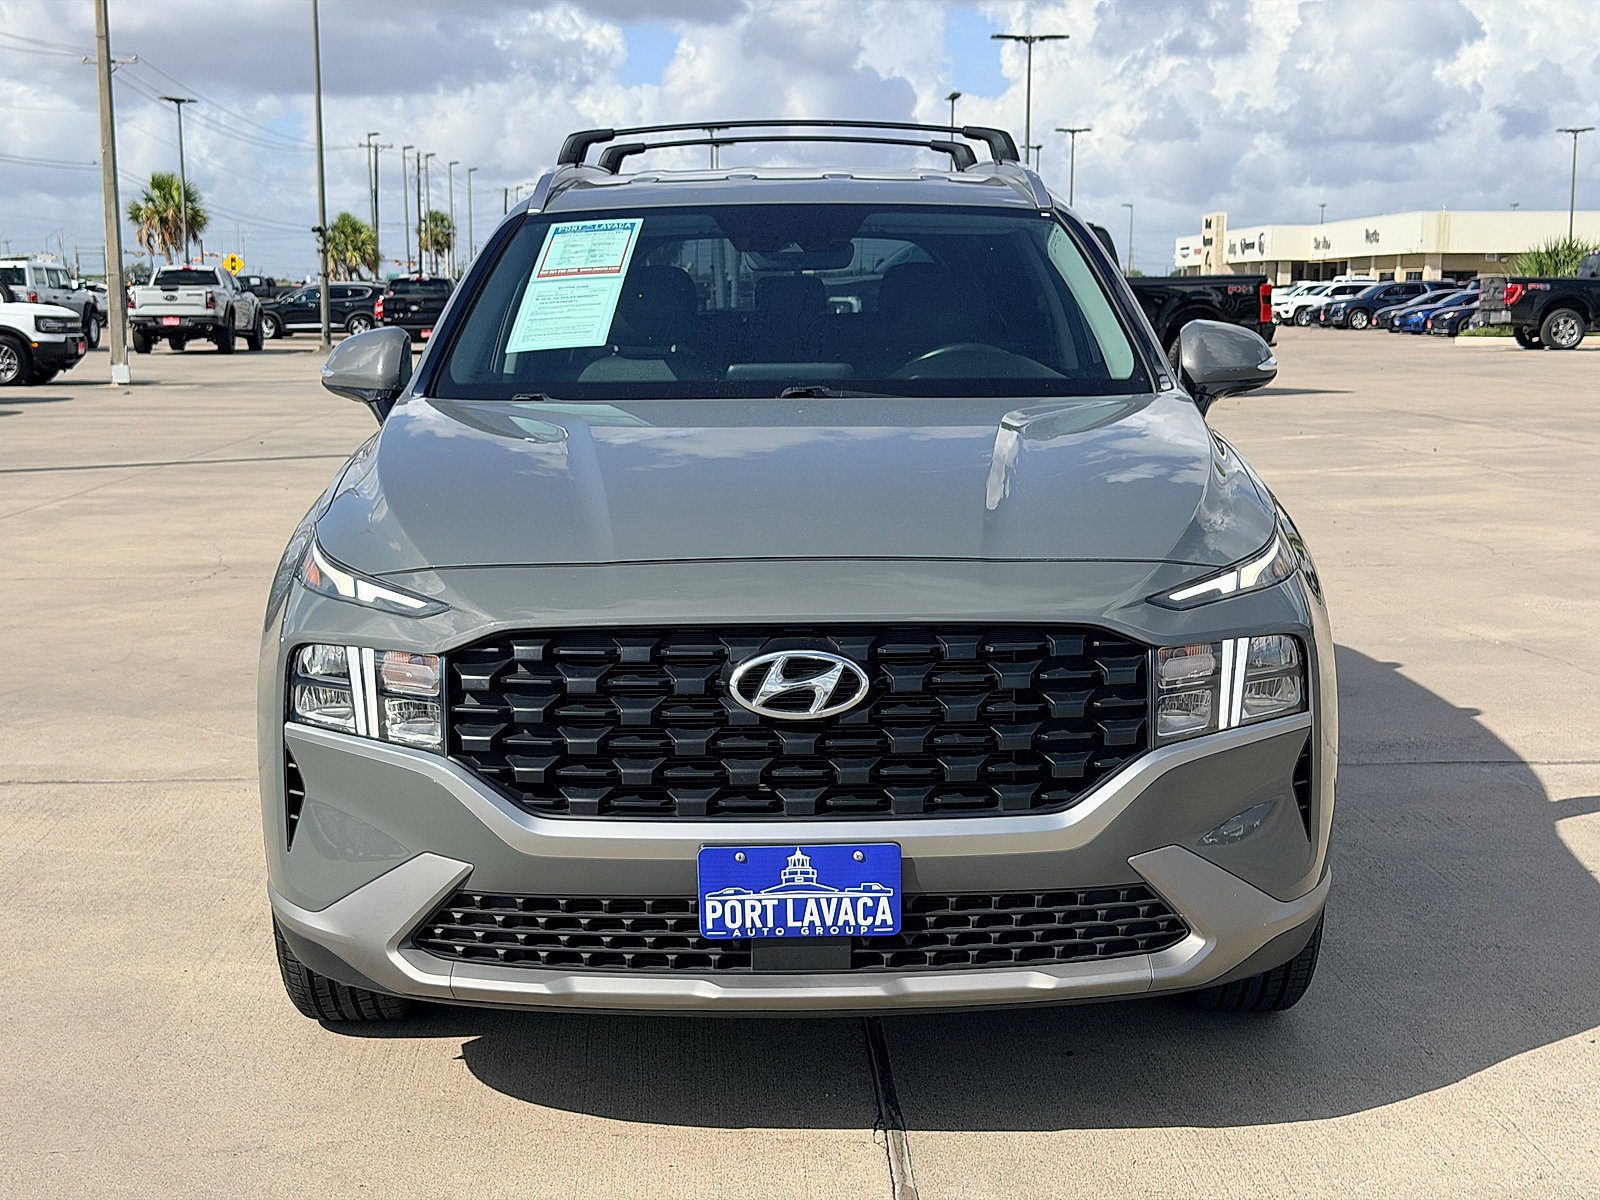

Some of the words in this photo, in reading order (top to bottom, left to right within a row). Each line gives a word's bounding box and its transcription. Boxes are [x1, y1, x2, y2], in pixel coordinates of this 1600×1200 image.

[705, 898, 779, 929] PORT
[787, 896, 894, 928] LAVACA
[732, 927, 785, 937] AUTO
[800, 926, 869, 935] GROUP
